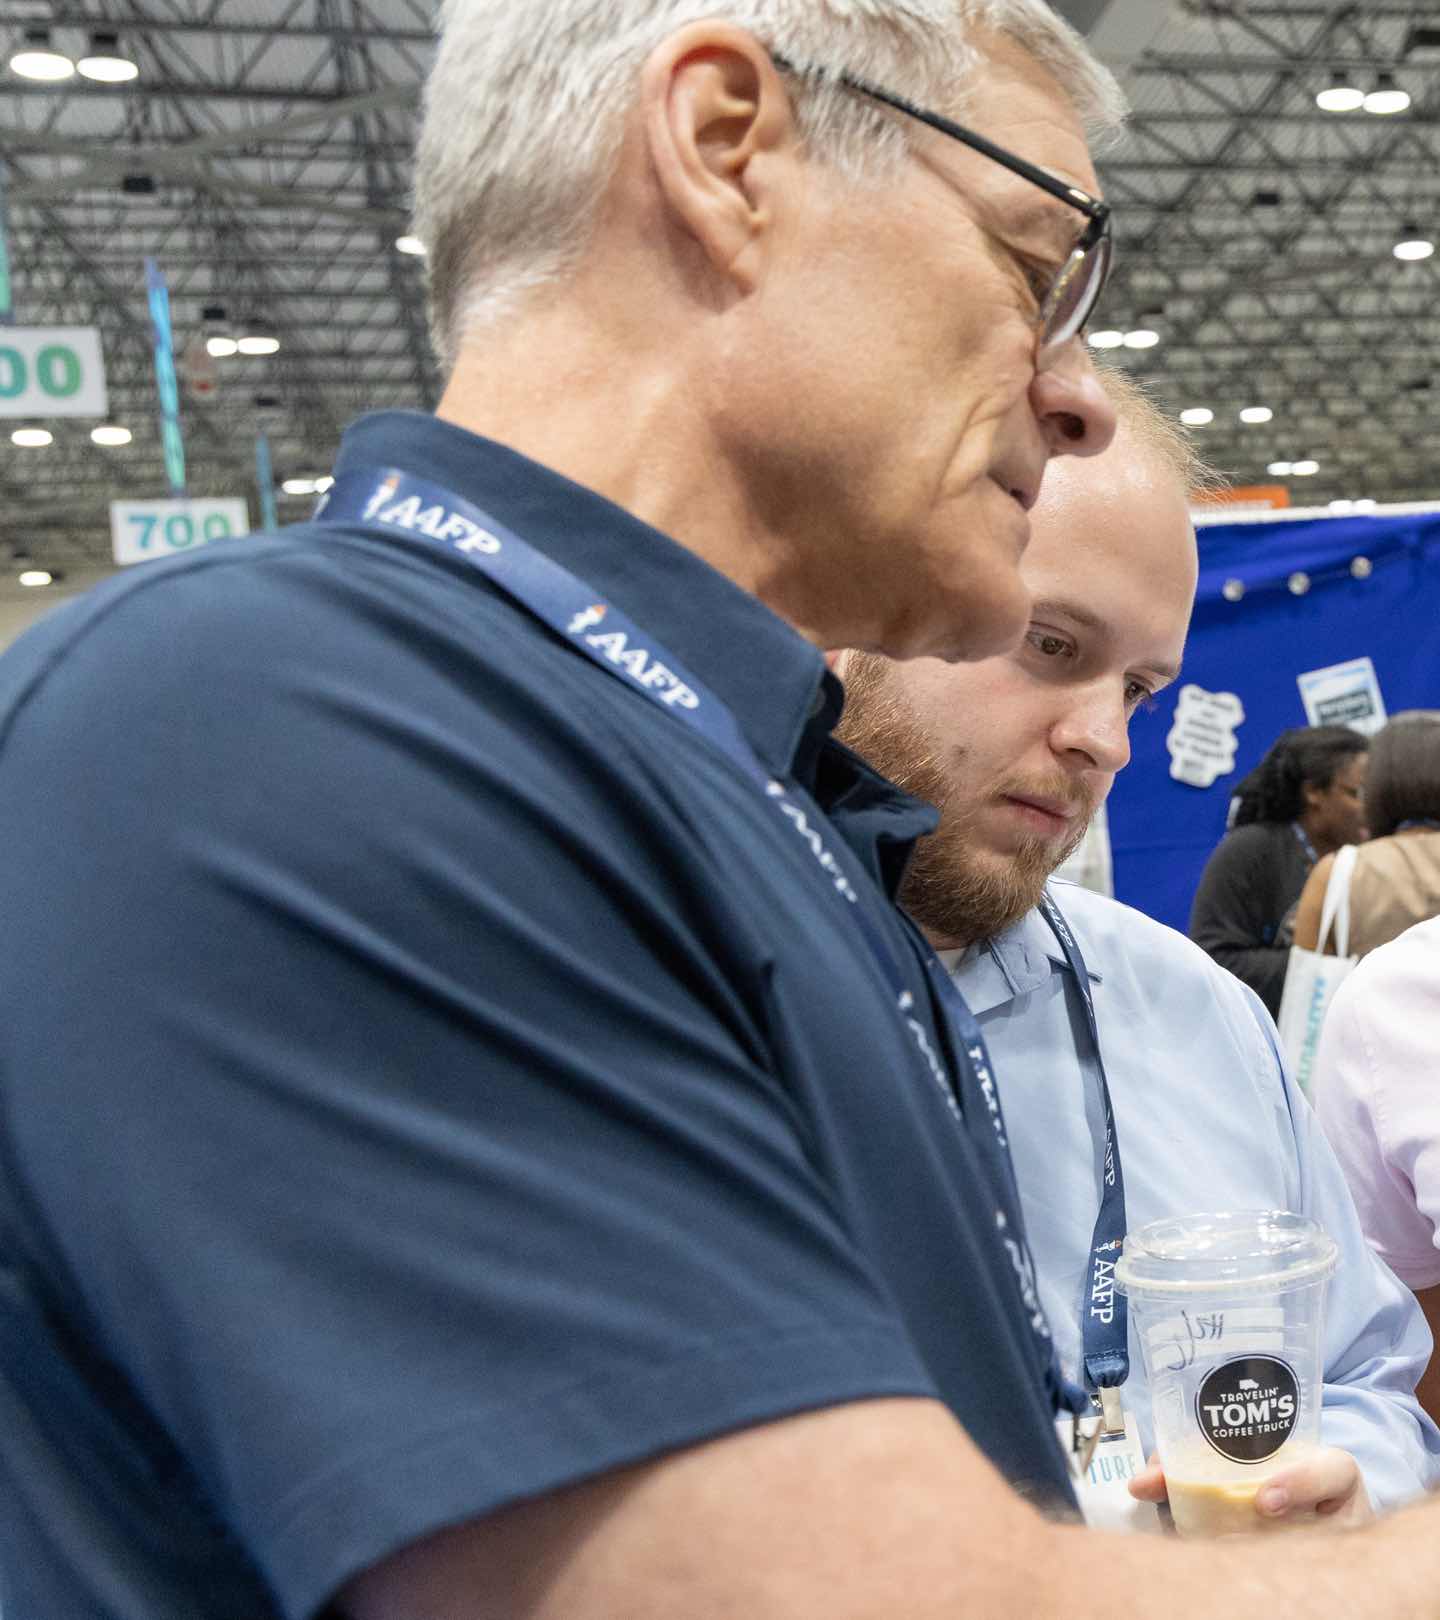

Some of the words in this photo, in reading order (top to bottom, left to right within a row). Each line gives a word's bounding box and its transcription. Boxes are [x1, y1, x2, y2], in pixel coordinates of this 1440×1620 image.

[0, 346, 81, 398] 00
[128, 513, 231, 548] 700
[378, 495, 502, 555] AAFP
[586, 631, 701, 710] AAFP
[1090, 1257, 1115, 1325] AAFP
[1203, 1394, 1295, 1427] TOM'S
[1220, 1387, 1279, 1403] TRAVELIN'
[1212, 1426, 1253, 1438] COFFEE
[1257, 1419, 1291, 1434] TRUCK
